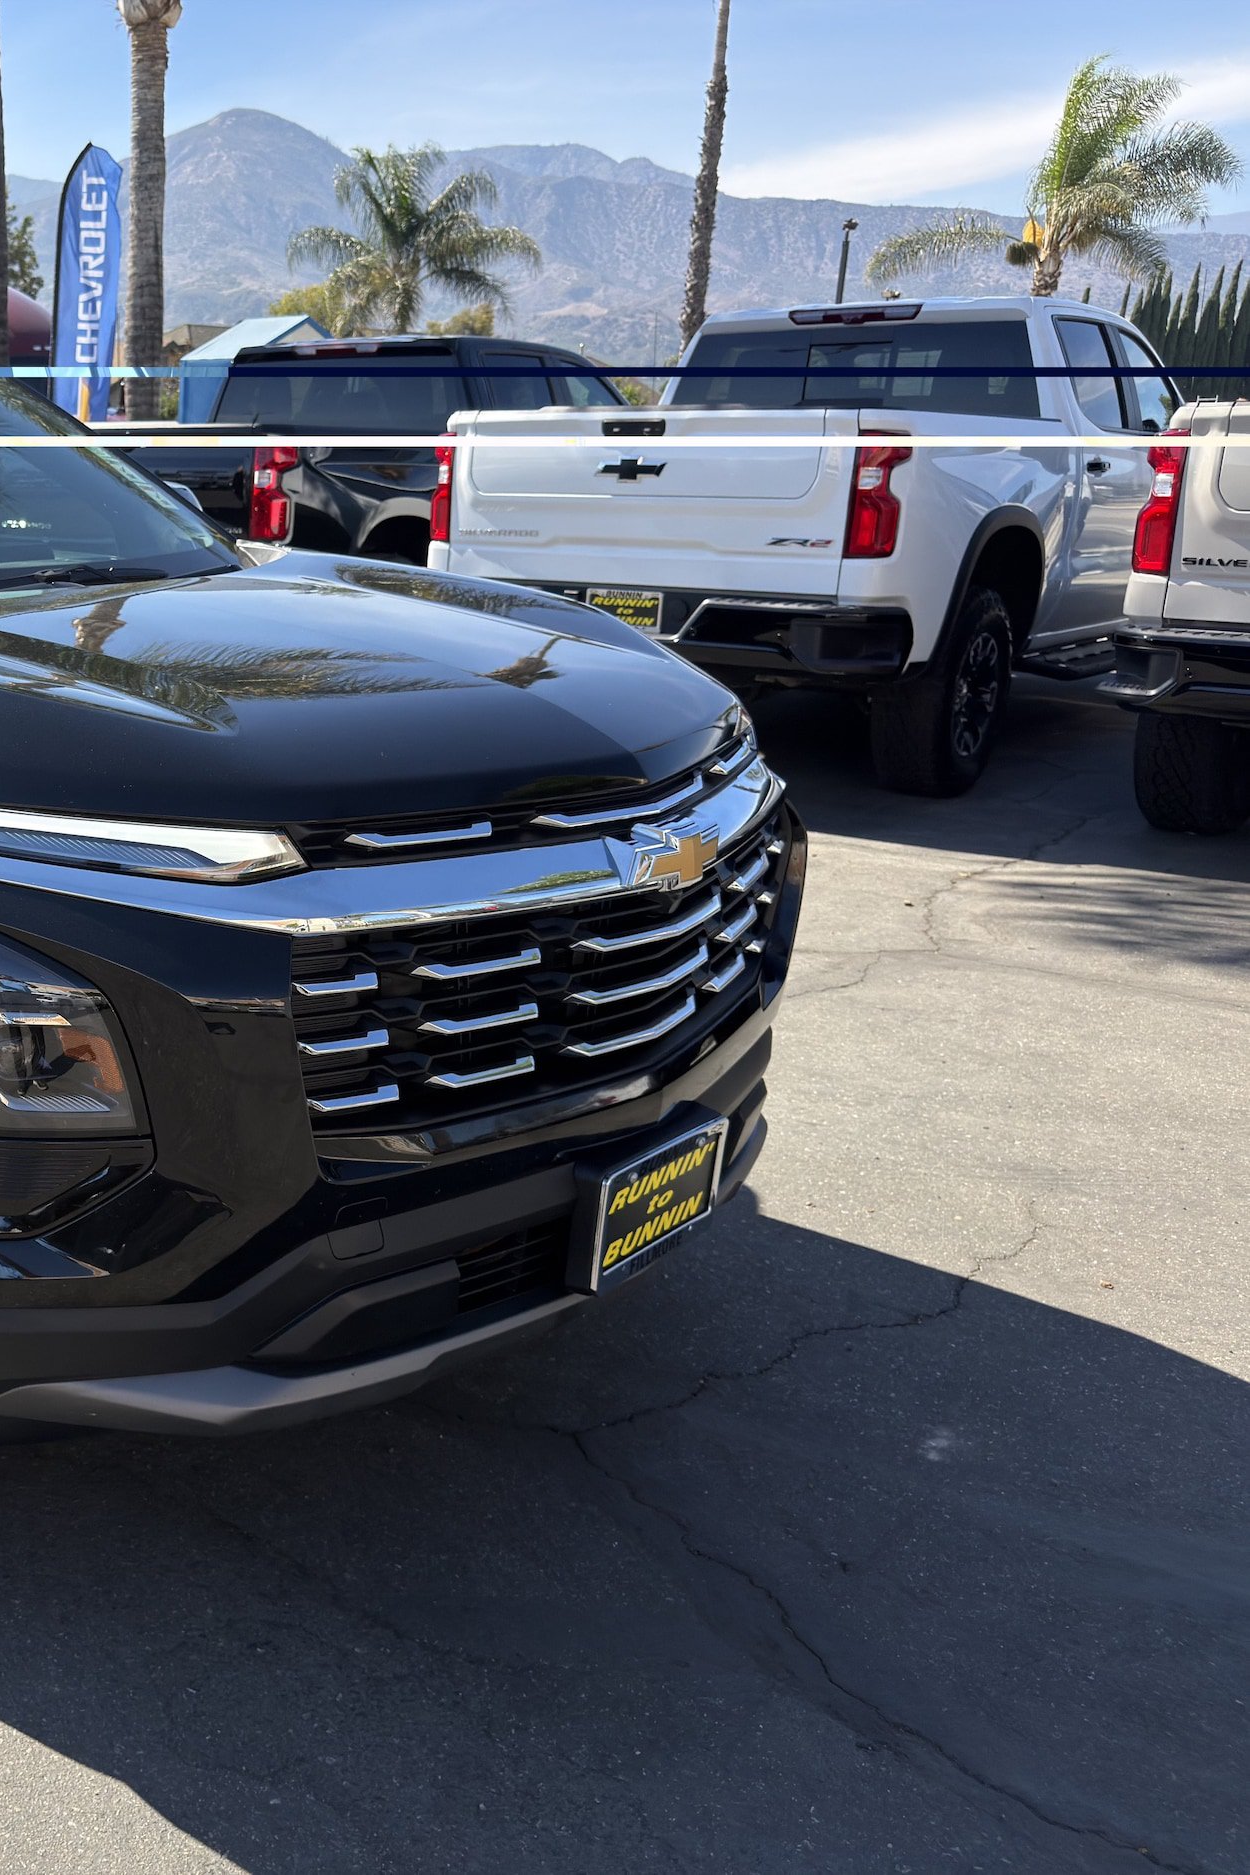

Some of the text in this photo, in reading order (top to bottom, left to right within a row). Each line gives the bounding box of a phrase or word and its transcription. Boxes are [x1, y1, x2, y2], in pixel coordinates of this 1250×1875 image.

[75, 170, 107, 364] CHEVROLET
[766, 537, 833, 548] ZR2
[1181, 557, 1250, 568] SILVE
[616, 607, 634, 615] to
[608, 1141, 716, 1216] RUNNIN'
[646, 1189, 674, 1215] to
[602, 1191, 704, 1268] BUNNIN
